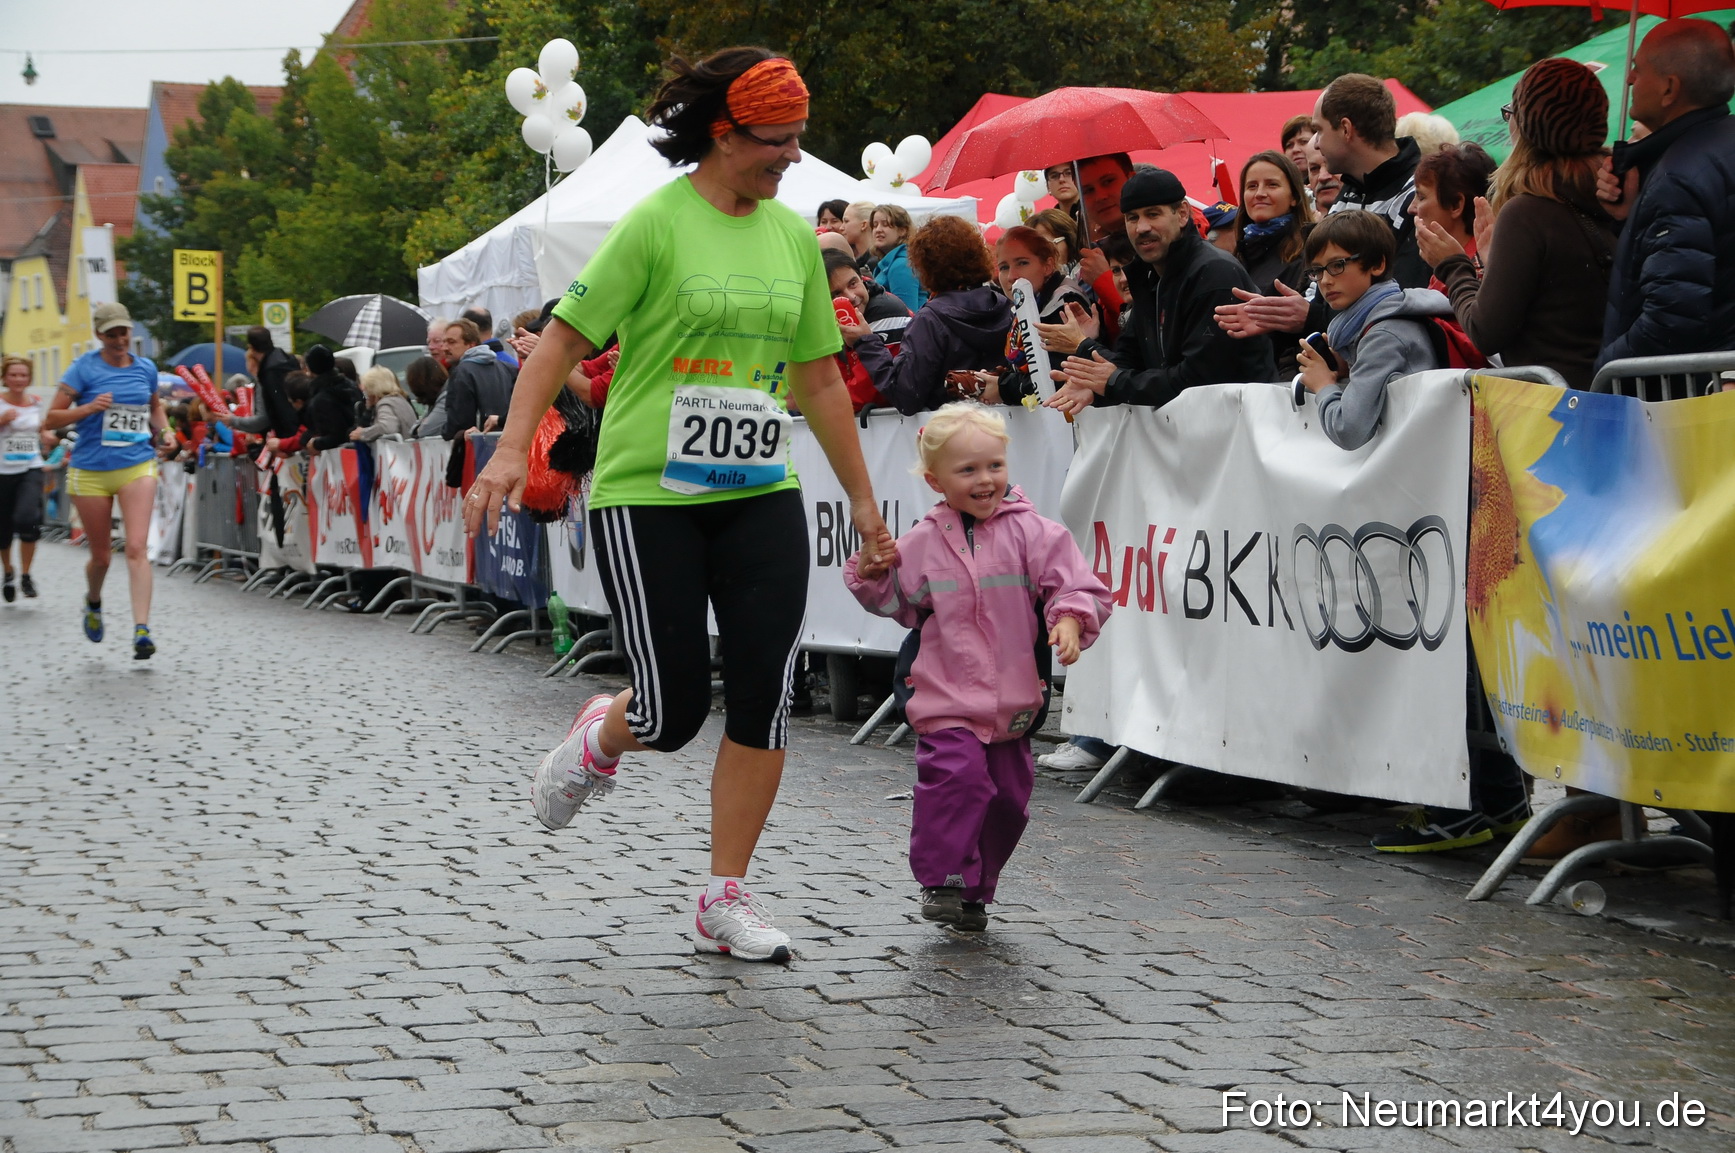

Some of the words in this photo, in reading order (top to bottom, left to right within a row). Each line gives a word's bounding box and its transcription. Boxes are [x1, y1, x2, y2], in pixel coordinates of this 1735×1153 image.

[180, 253, 217, 266] Block
[188, 272, 209, 305] B
[673, 357, 733, 377] MERZ
[675, 396, 716, 409] PARTL
[681, 414, 781, 460] 2039
[706, 469, 747, 485] Anita
[816, 500, 889, 568] BM
[1183, 529, 1296, 632] BKK
